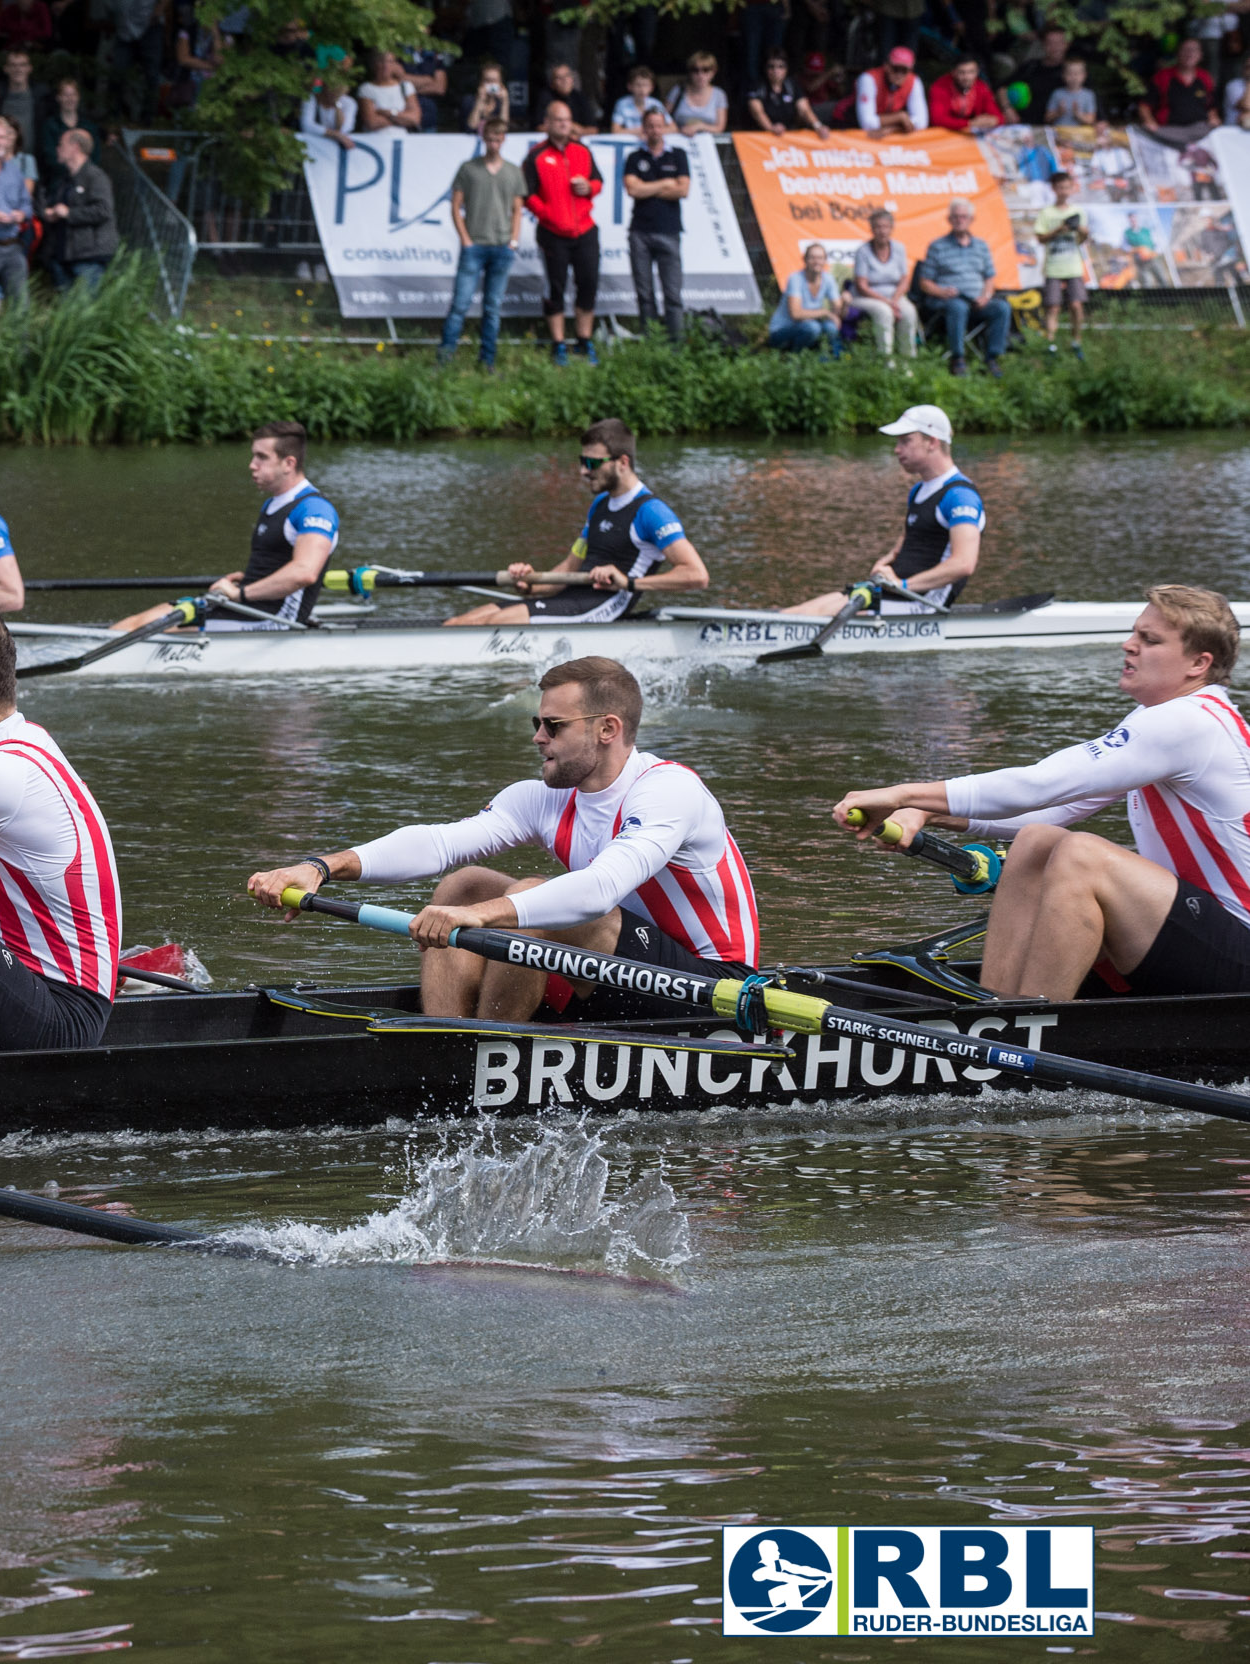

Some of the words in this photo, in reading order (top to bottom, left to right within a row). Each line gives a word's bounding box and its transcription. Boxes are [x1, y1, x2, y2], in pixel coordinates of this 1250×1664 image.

[343, 246, 454, 265] consulting
[785, 622, 940, 641] RUD-BUNDESLIGA
[507, 940, 708, 1003] BRUNCKHORST
[877, 1028, 945, 1053] SCHNELL.
[946, 1042, 980, 1059] GUT.
[998, 1051, 1025, 1066] RBL
